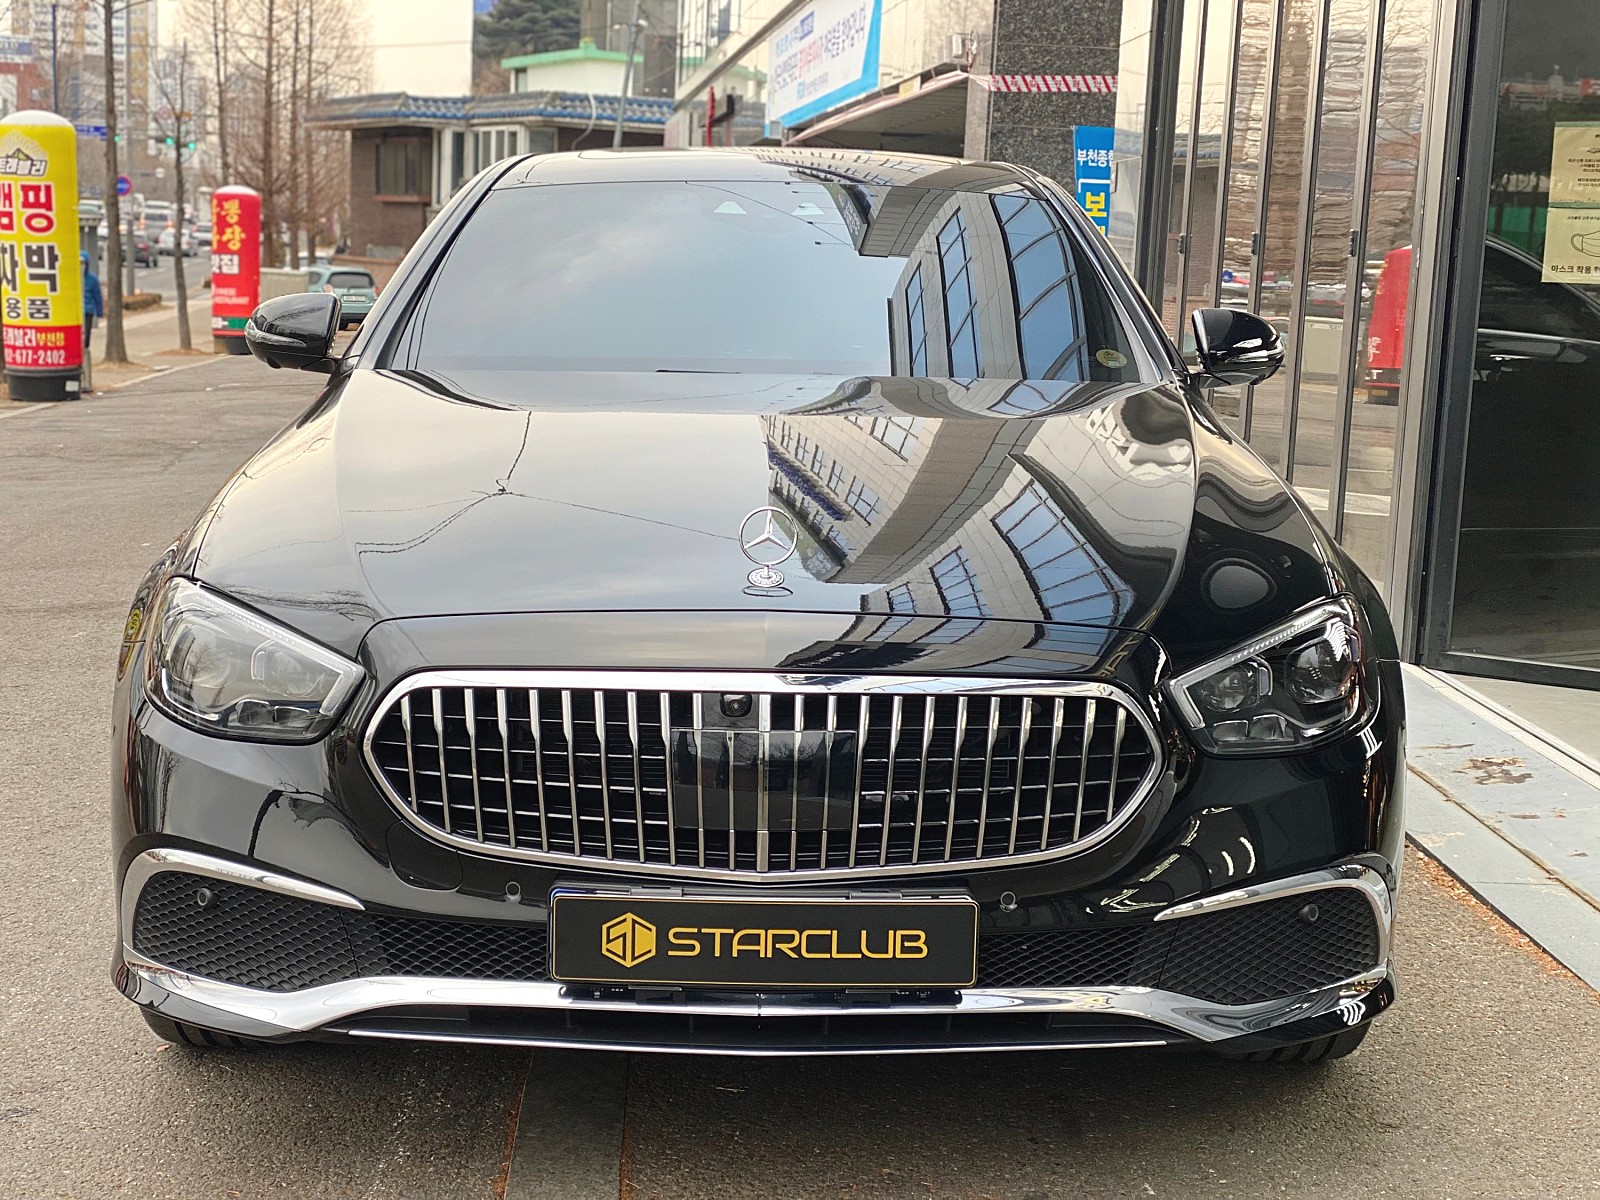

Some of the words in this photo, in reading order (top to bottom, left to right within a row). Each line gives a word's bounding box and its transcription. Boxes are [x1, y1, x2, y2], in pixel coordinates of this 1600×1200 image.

[1551, 264, 1575, 274] 마스크
[1576, 265, 1592, 275] 착용
[6, 297, 50, 320] 용품
[667, 927, 929, 959] STARCLUB
